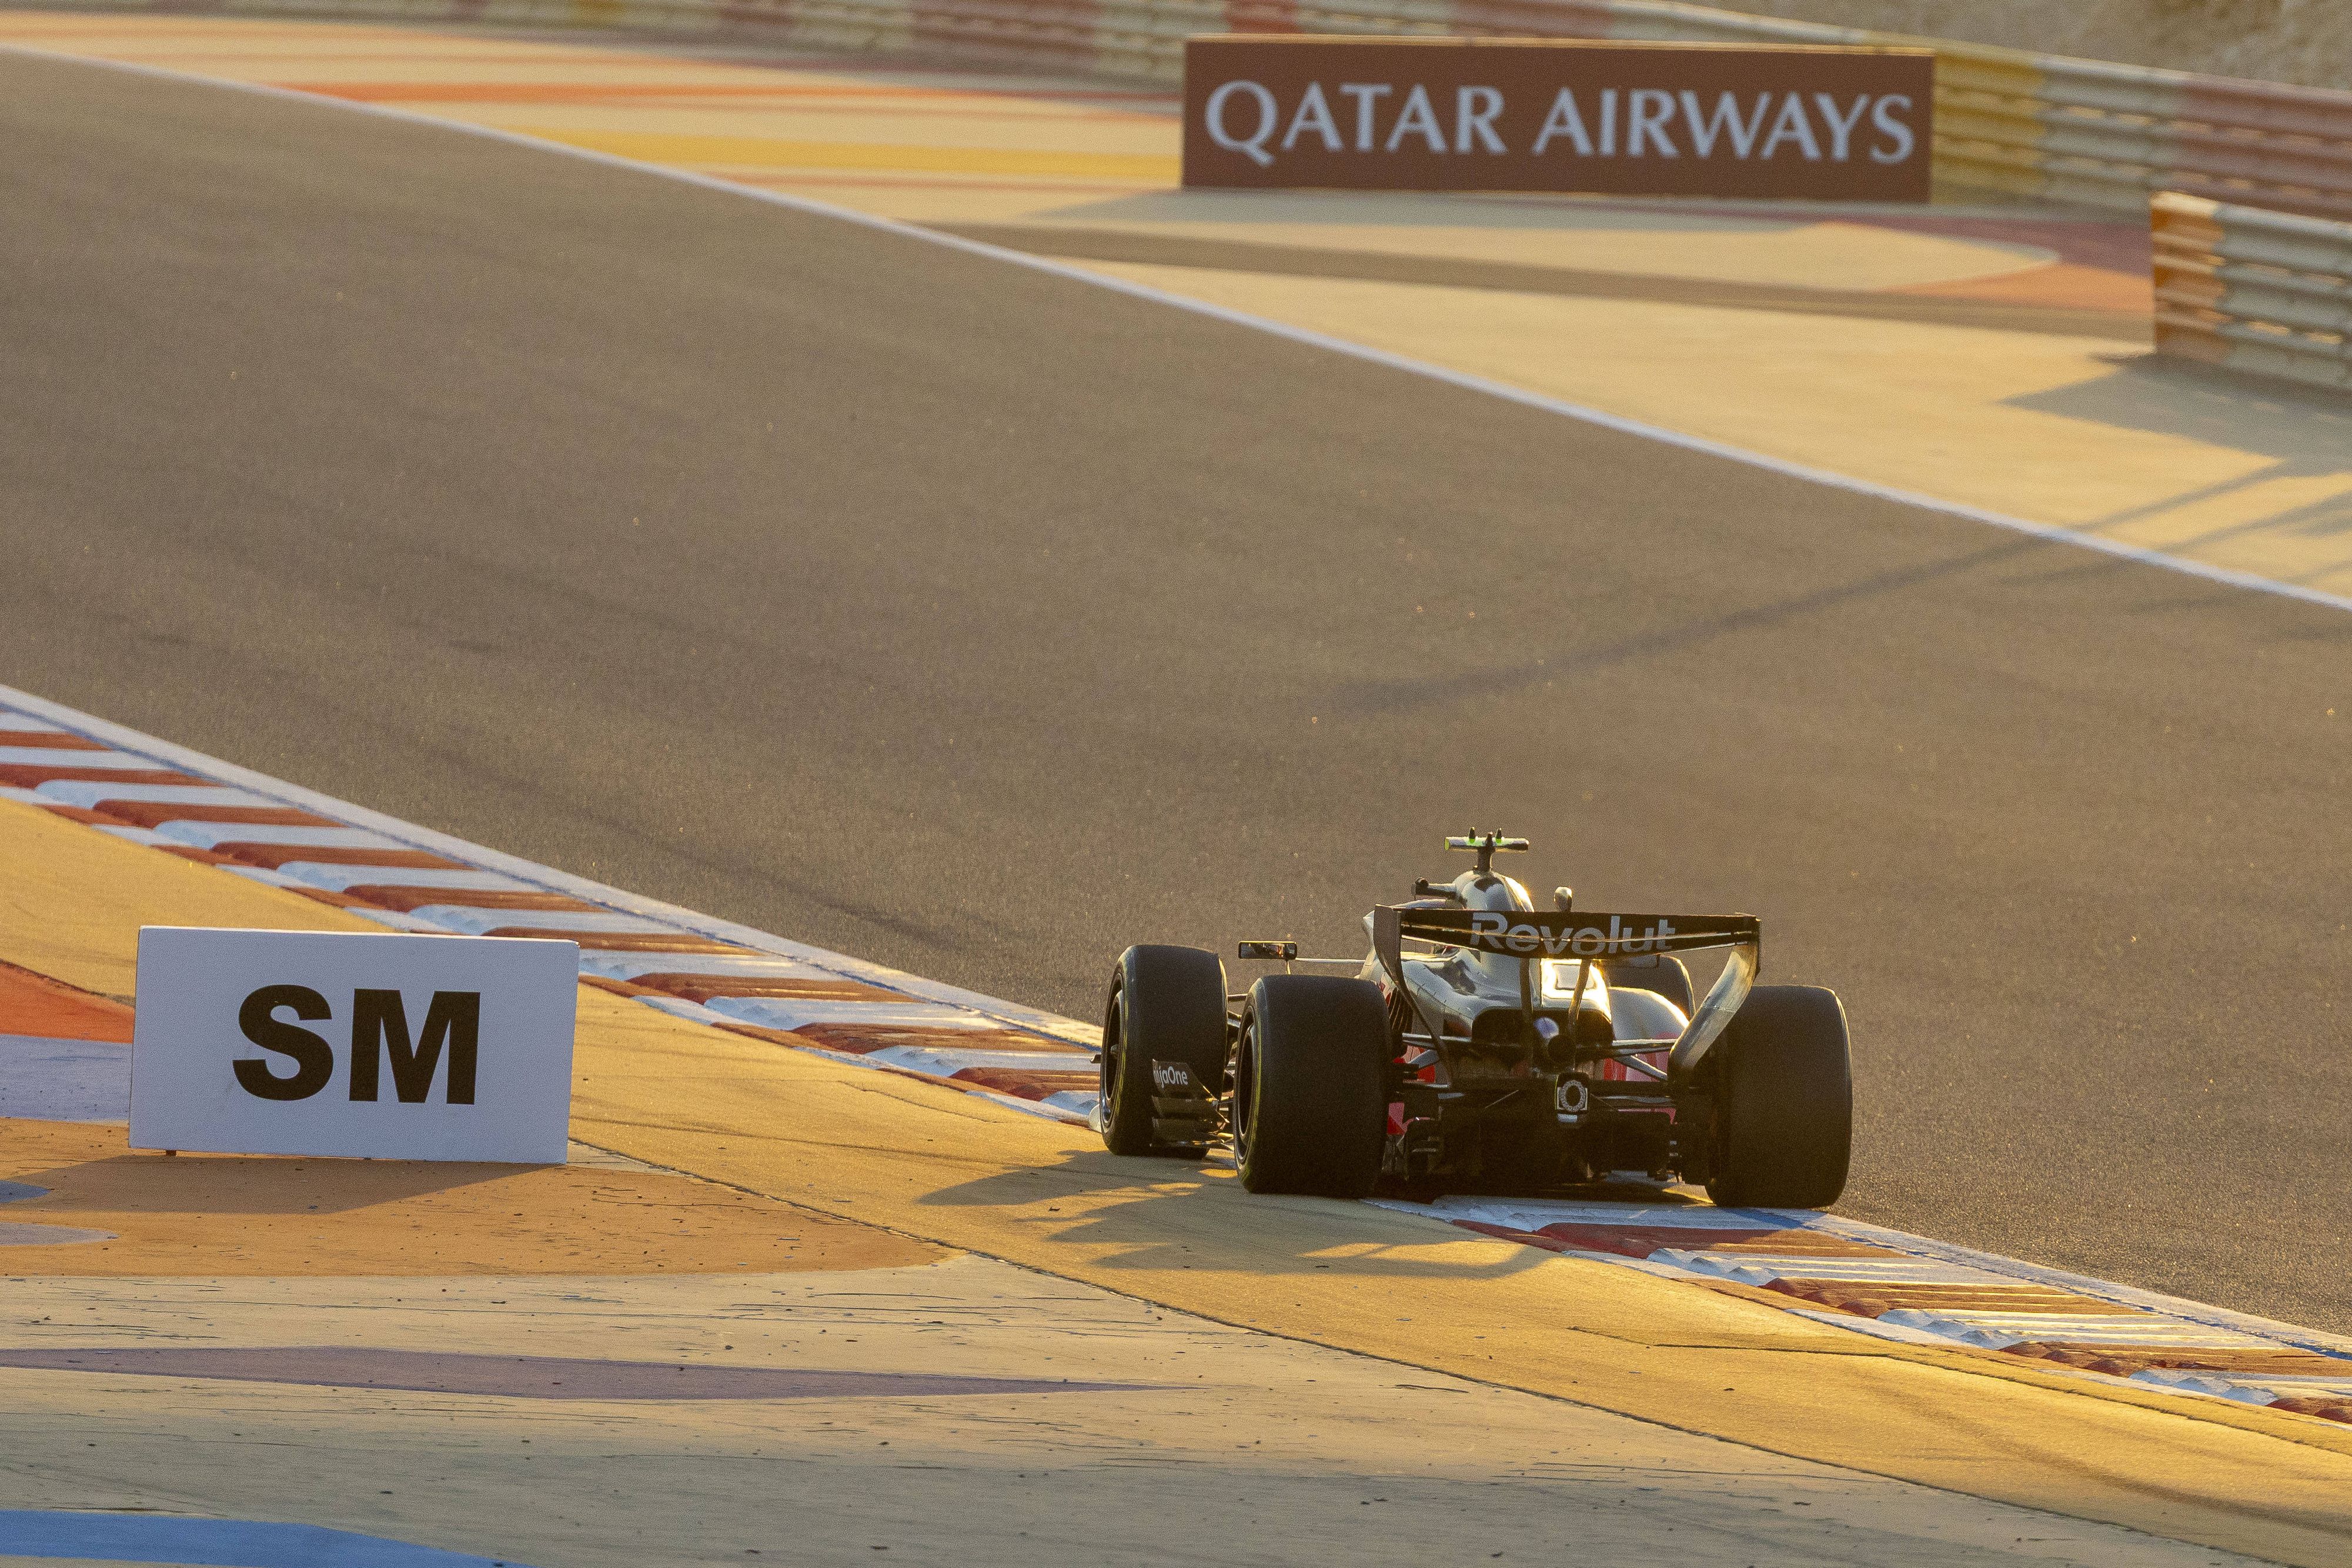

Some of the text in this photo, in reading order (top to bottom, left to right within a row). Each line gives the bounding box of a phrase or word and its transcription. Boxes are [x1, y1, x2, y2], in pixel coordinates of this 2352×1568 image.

[1204, 80, 1914, 166] QATAR AIRWAYS
[1470, 912, 1675, 955] Revolut
[233, 984, 480, 1105] SM
